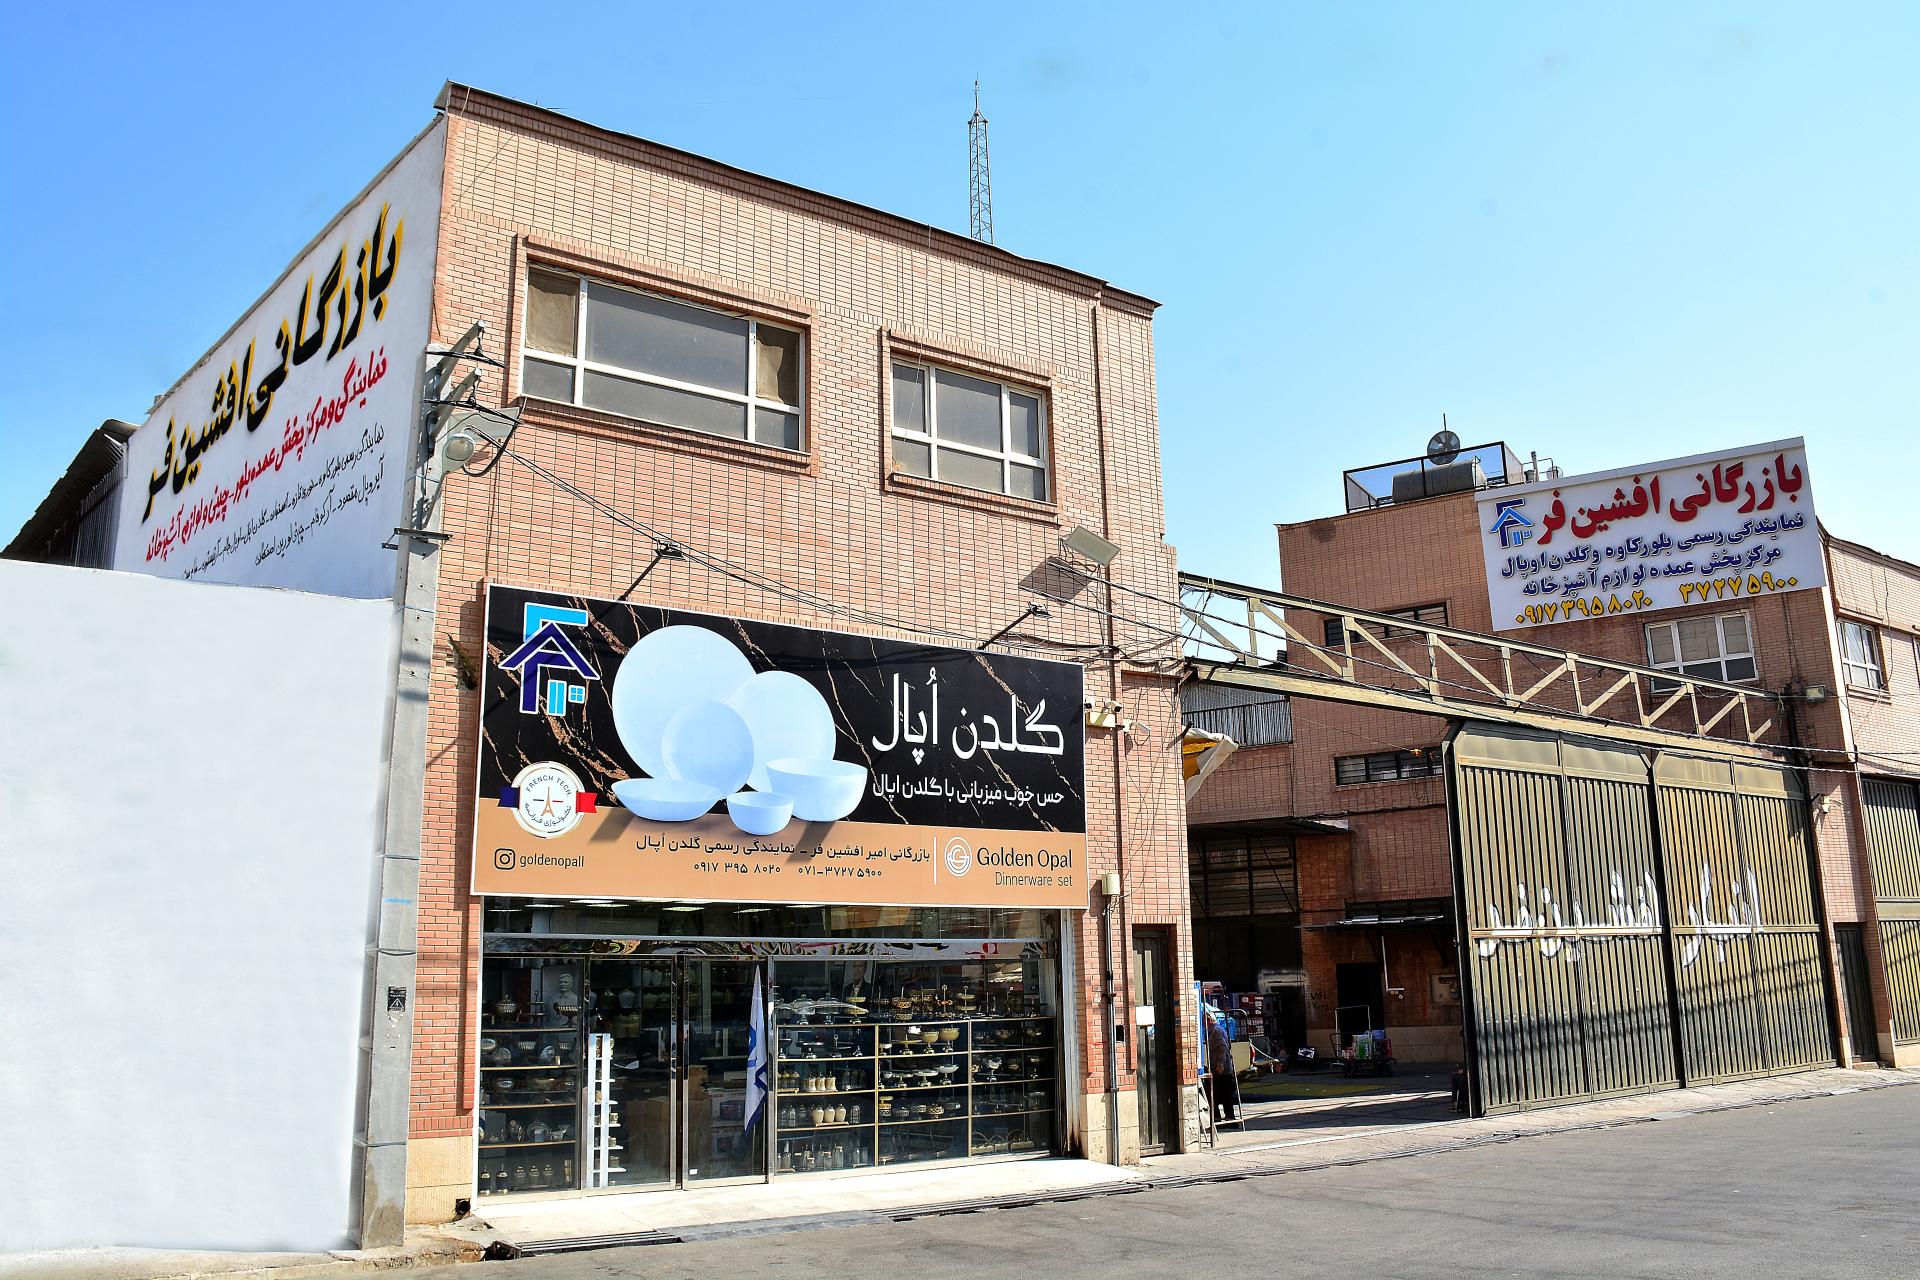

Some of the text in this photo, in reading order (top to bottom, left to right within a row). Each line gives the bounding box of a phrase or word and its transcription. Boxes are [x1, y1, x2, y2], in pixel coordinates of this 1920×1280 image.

[140, 201, 403, 526] بازرگانی افشین فر
[334, 344, 388, 424] نمایندگی
[304, 396, 328, 447] مرکز
[275, 416, 305, 471] پخش
[251, 448, 275, 482] عمده
[233, 461, 251, 504] بلور
[208, 485, 230, 523] چینی
[1537, 453, 1803, 545] بازرگانی افشین فر
[181, 498, 203, 545] لوازم
[1727, 511, 1805, 544] نمایندگی
[1605, 536, 1642, 562] کاوه
[1639, 532, 1673, 558] بلور
[1677, 531, 1724, 552] رسمی
[1501, 551, 1547, 579] اوپال
[1522, 543, 1782, 598] مرکز پخش عمده لوازم آشپزخانه
[1549, 544, 1591, 571] گلدن
[952, 693, 1065, 760] گلدن
[526, 774, 572, 797] FRENCH TECH
[873, 773, 1065, 807] حس خوب میزبانی با گلدن اپال
[668, 836, 701, 851] گلدن
[704, 841, 739, 855] رسمی
[742, 840, 795, 856] نمایندگی
[810, 843, 823, 857] فر
[826, 844, 864, 859] افشین
[865, 846, 887, 861] امیر
[889, 846, 931, 862] بازرگانی
[519, 853, 585, 870] goldenopall
[693, 861, 719, 873] ۰۹۱۷
[724, 862, 749, 874] ۳۹۵
[753, 863, 782, 875] ۸۰۲۰
[976, 846, 1072, 871] Golden Opal
[995, 872, 1073, 887] Dinnerware set
